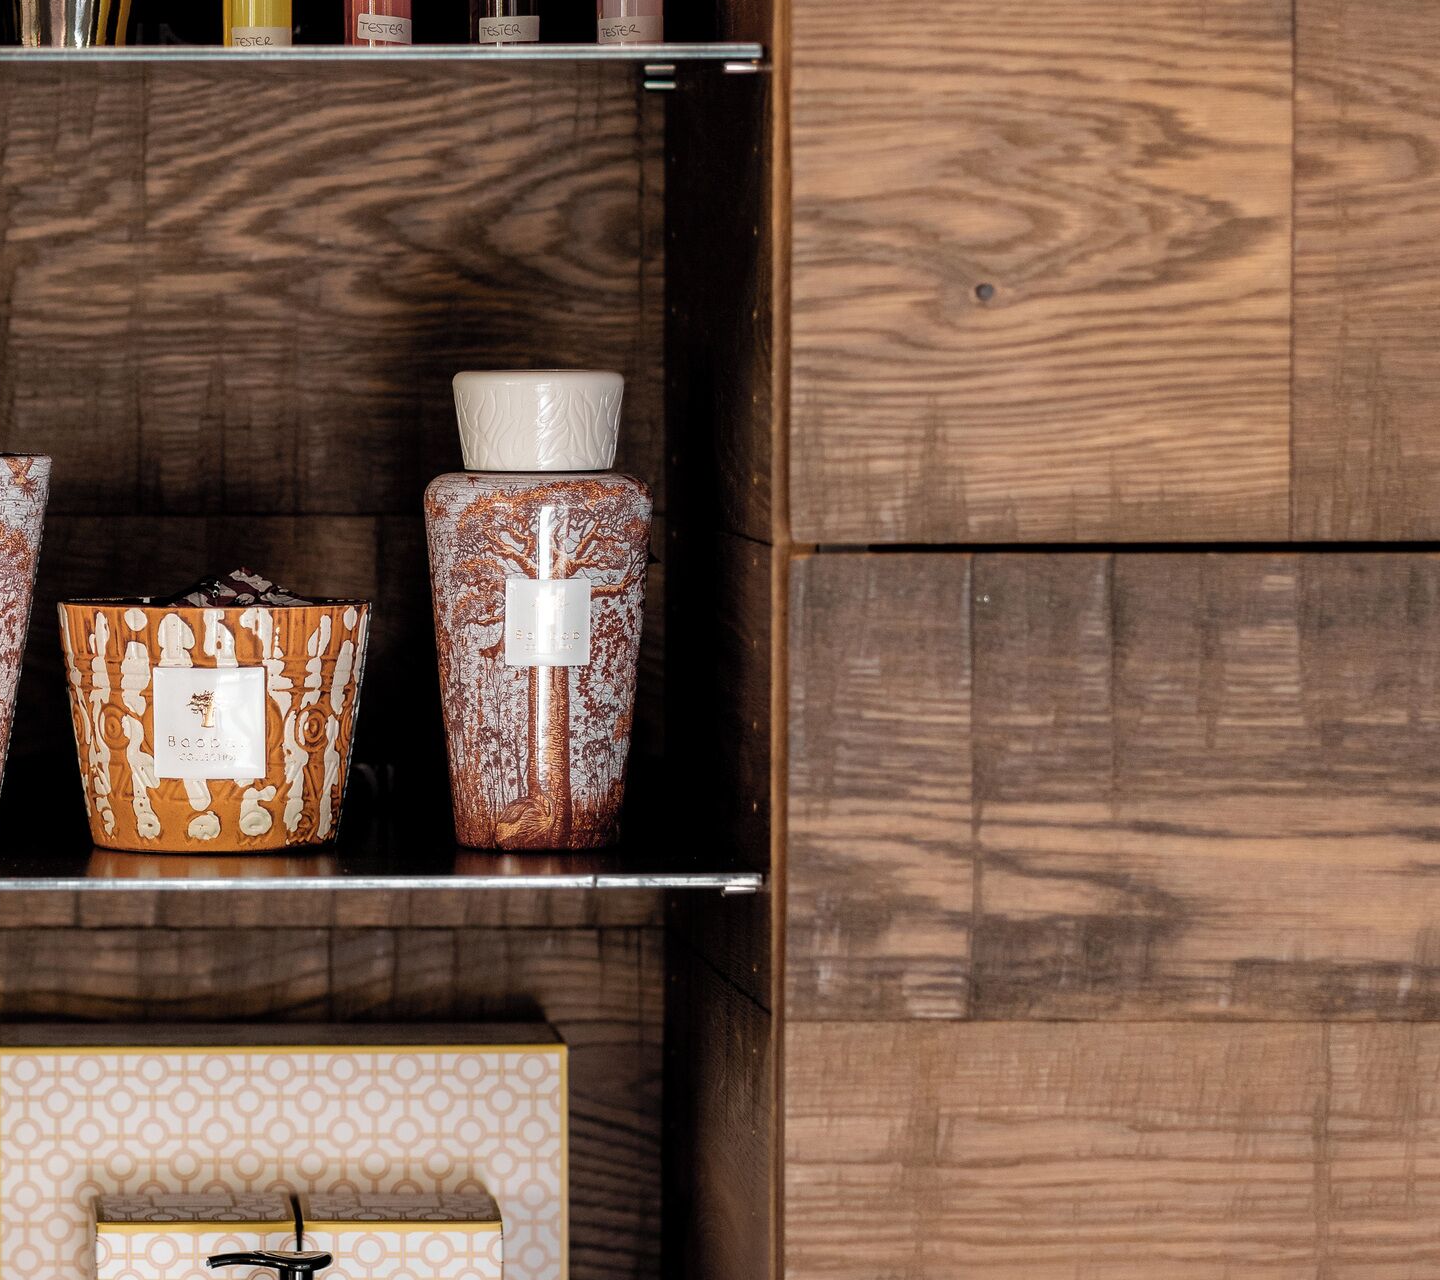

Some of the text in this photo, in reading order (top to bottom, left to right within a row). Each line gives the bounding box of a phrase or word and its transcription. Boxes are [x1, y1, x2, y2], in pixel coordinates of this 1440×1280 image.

[359, 21, 403, 35] TESTER
[481, 23, 521, 37] TESTER
[601, 24, 640, 37] TESTER
[235, 36, 273, 47] TESTER
